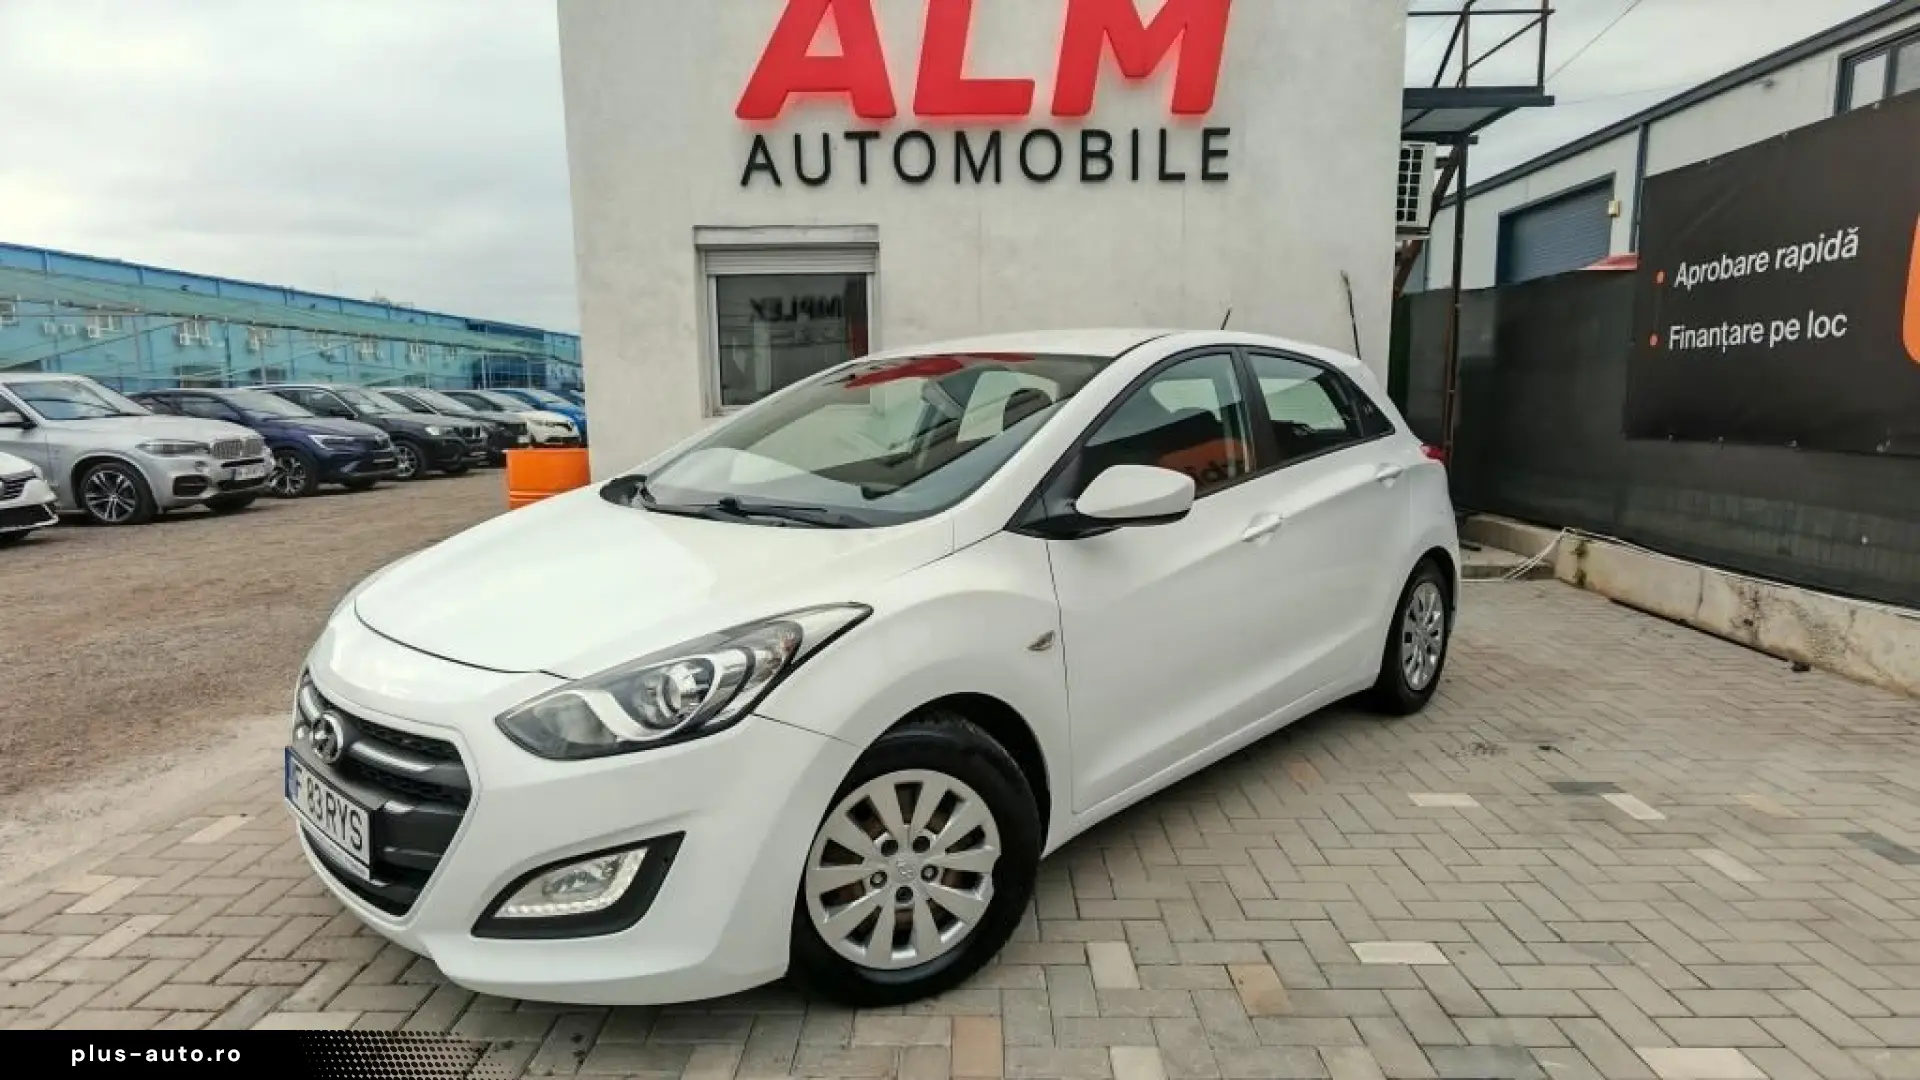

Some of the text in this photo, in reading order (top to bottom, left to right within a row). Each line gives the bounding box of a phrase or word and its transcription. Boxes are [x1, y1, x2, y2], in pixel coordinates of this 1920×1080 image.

[735, 0, 1231, 118] ALM
[741, 127, 1230, 187] AUTOMOBILE
[1674, 226, 1860, 291] Aprobare rapidă
[1668, 309, 1848, 354] Finanțare pe loc
[326, 790, 363, 851] RYS
